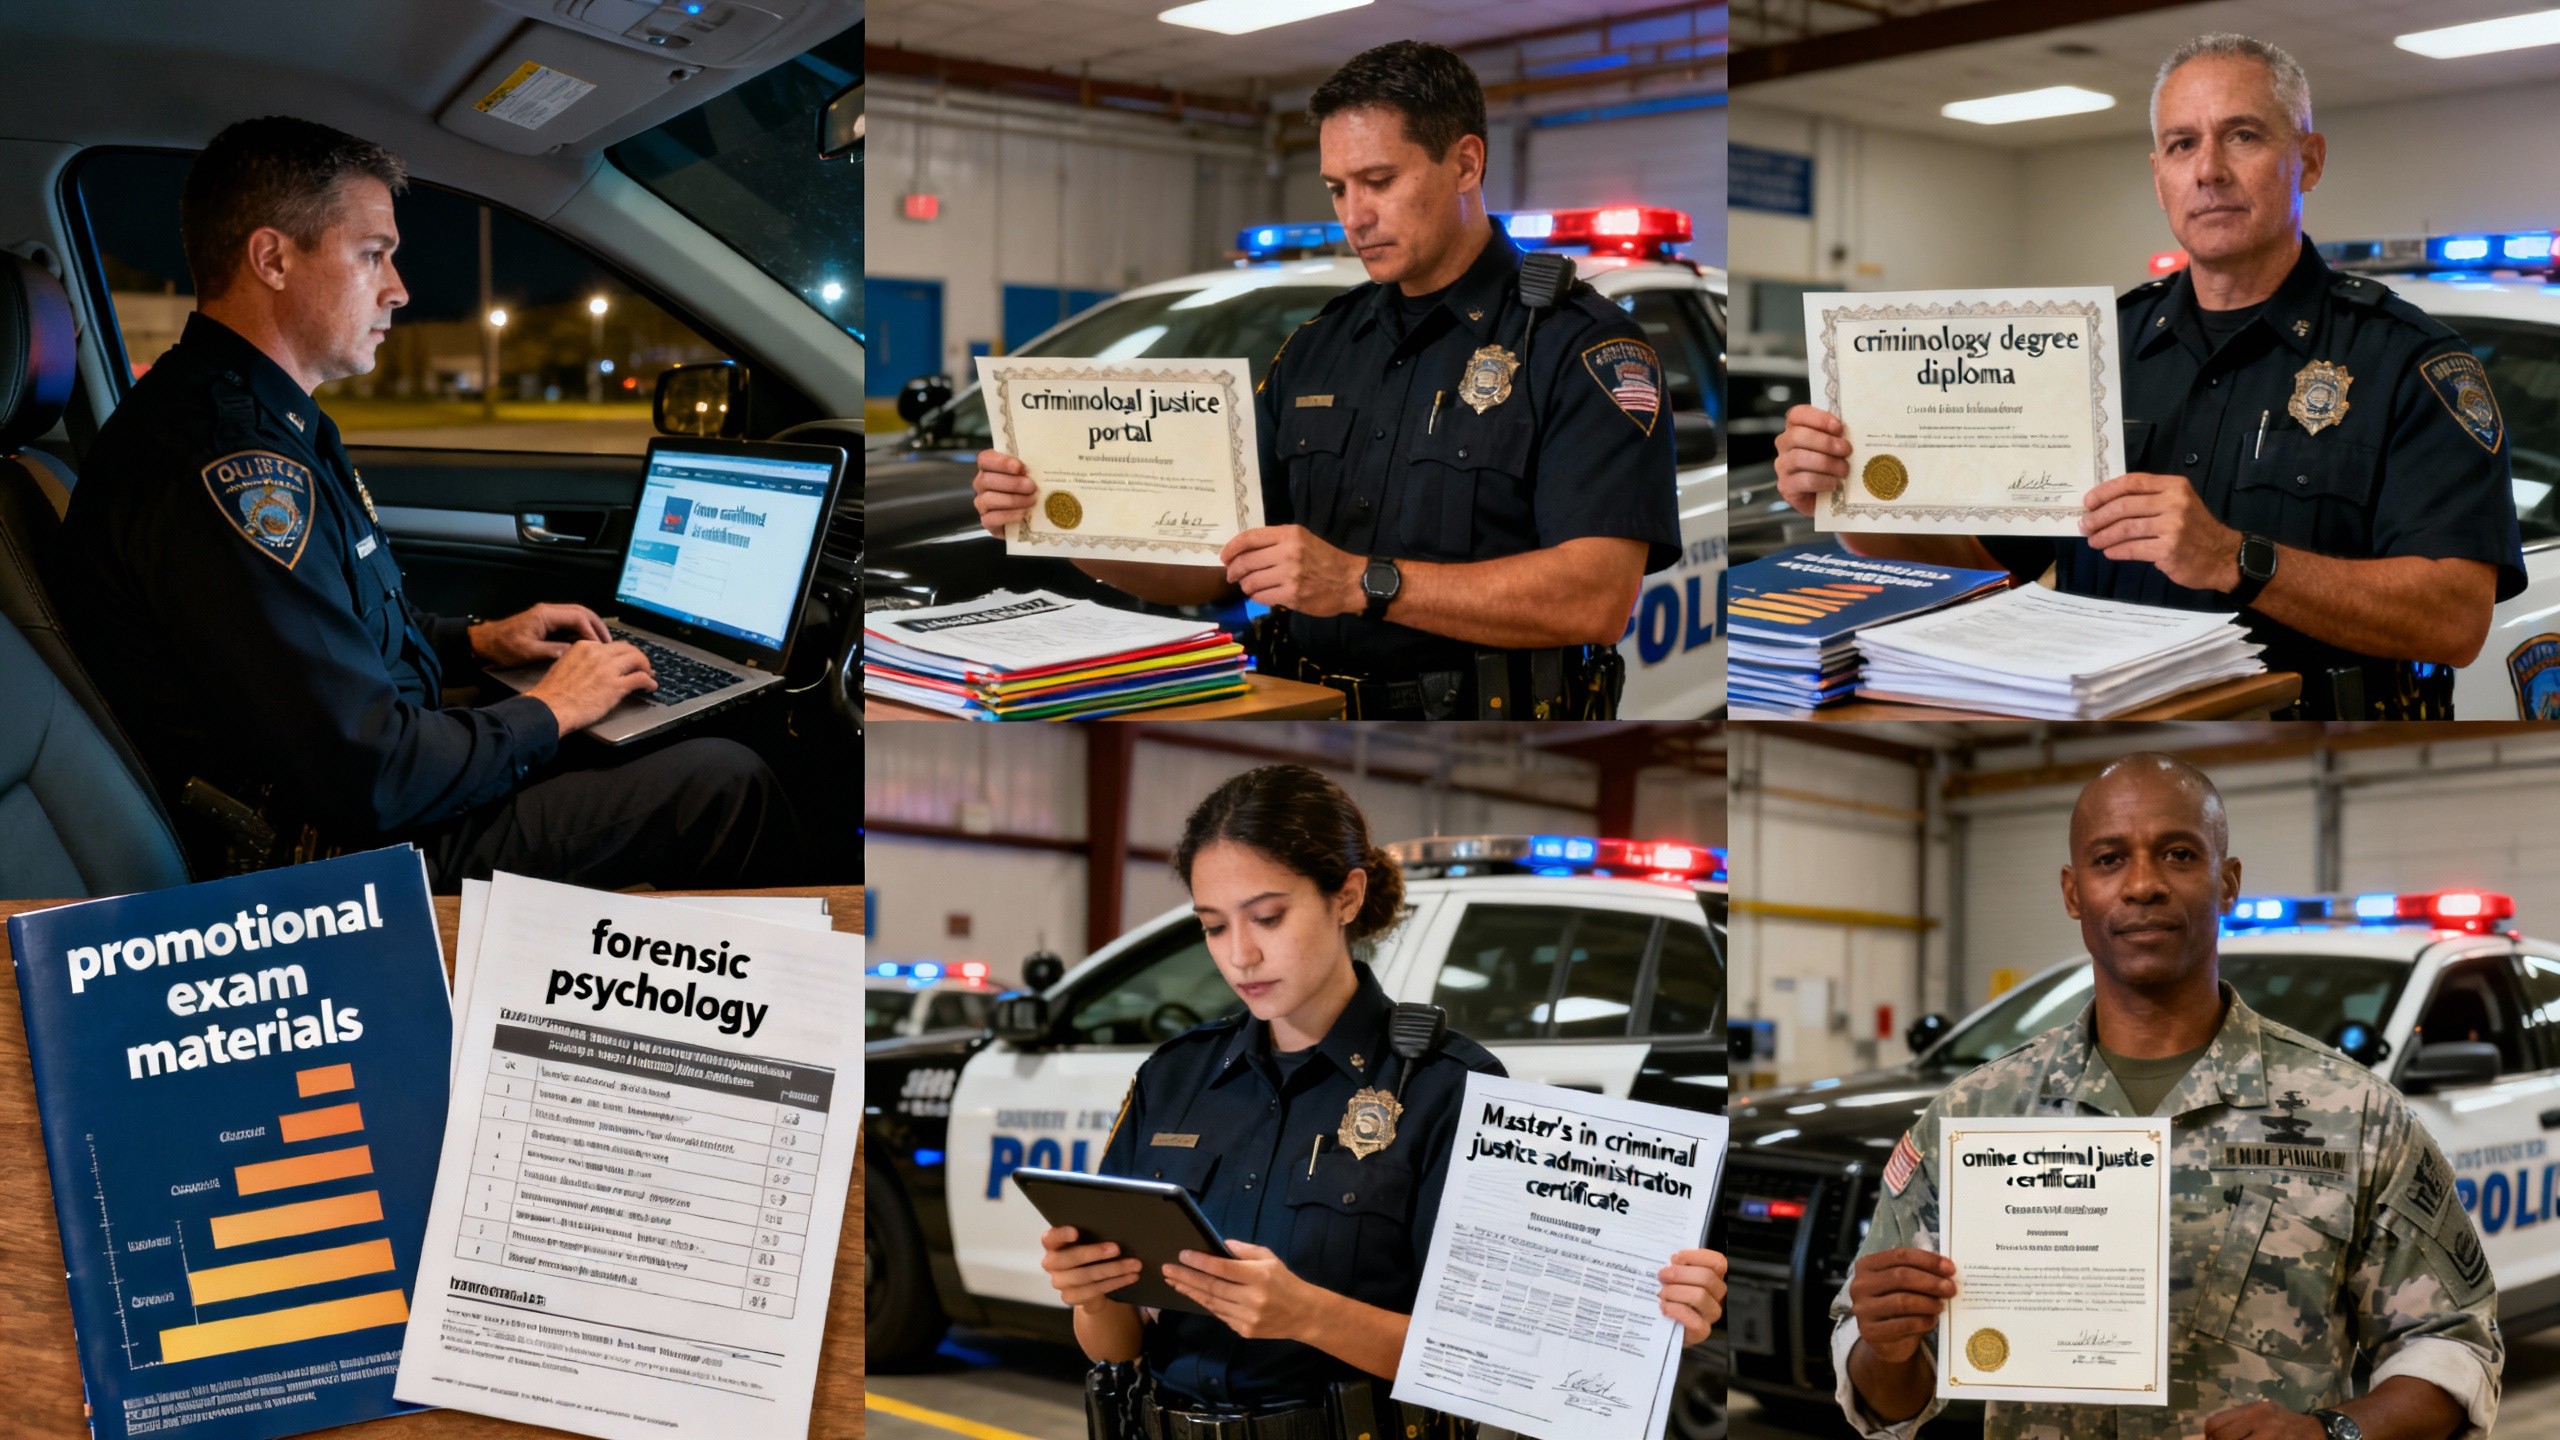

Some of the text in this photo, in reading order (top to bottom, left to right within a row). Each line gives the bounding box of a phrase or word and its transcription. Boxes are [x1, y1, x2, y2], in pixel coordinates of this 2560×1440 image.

[2000, 324, 2079, 358] degree
[1917, 356, 2016, 393] diploma
[1147, 389, 1220, 419] justice
[1089, 420, 1153, 450] portal
[67, 882, 384, 994] promotional
[591, 918, 751, 980] forensic
[167, 964, 308, 1017] exam
[545, 969, 769, 1039] psychology
[126, 998, 364, 1080] materials
[1579, 1117, 1598, 1146] in
